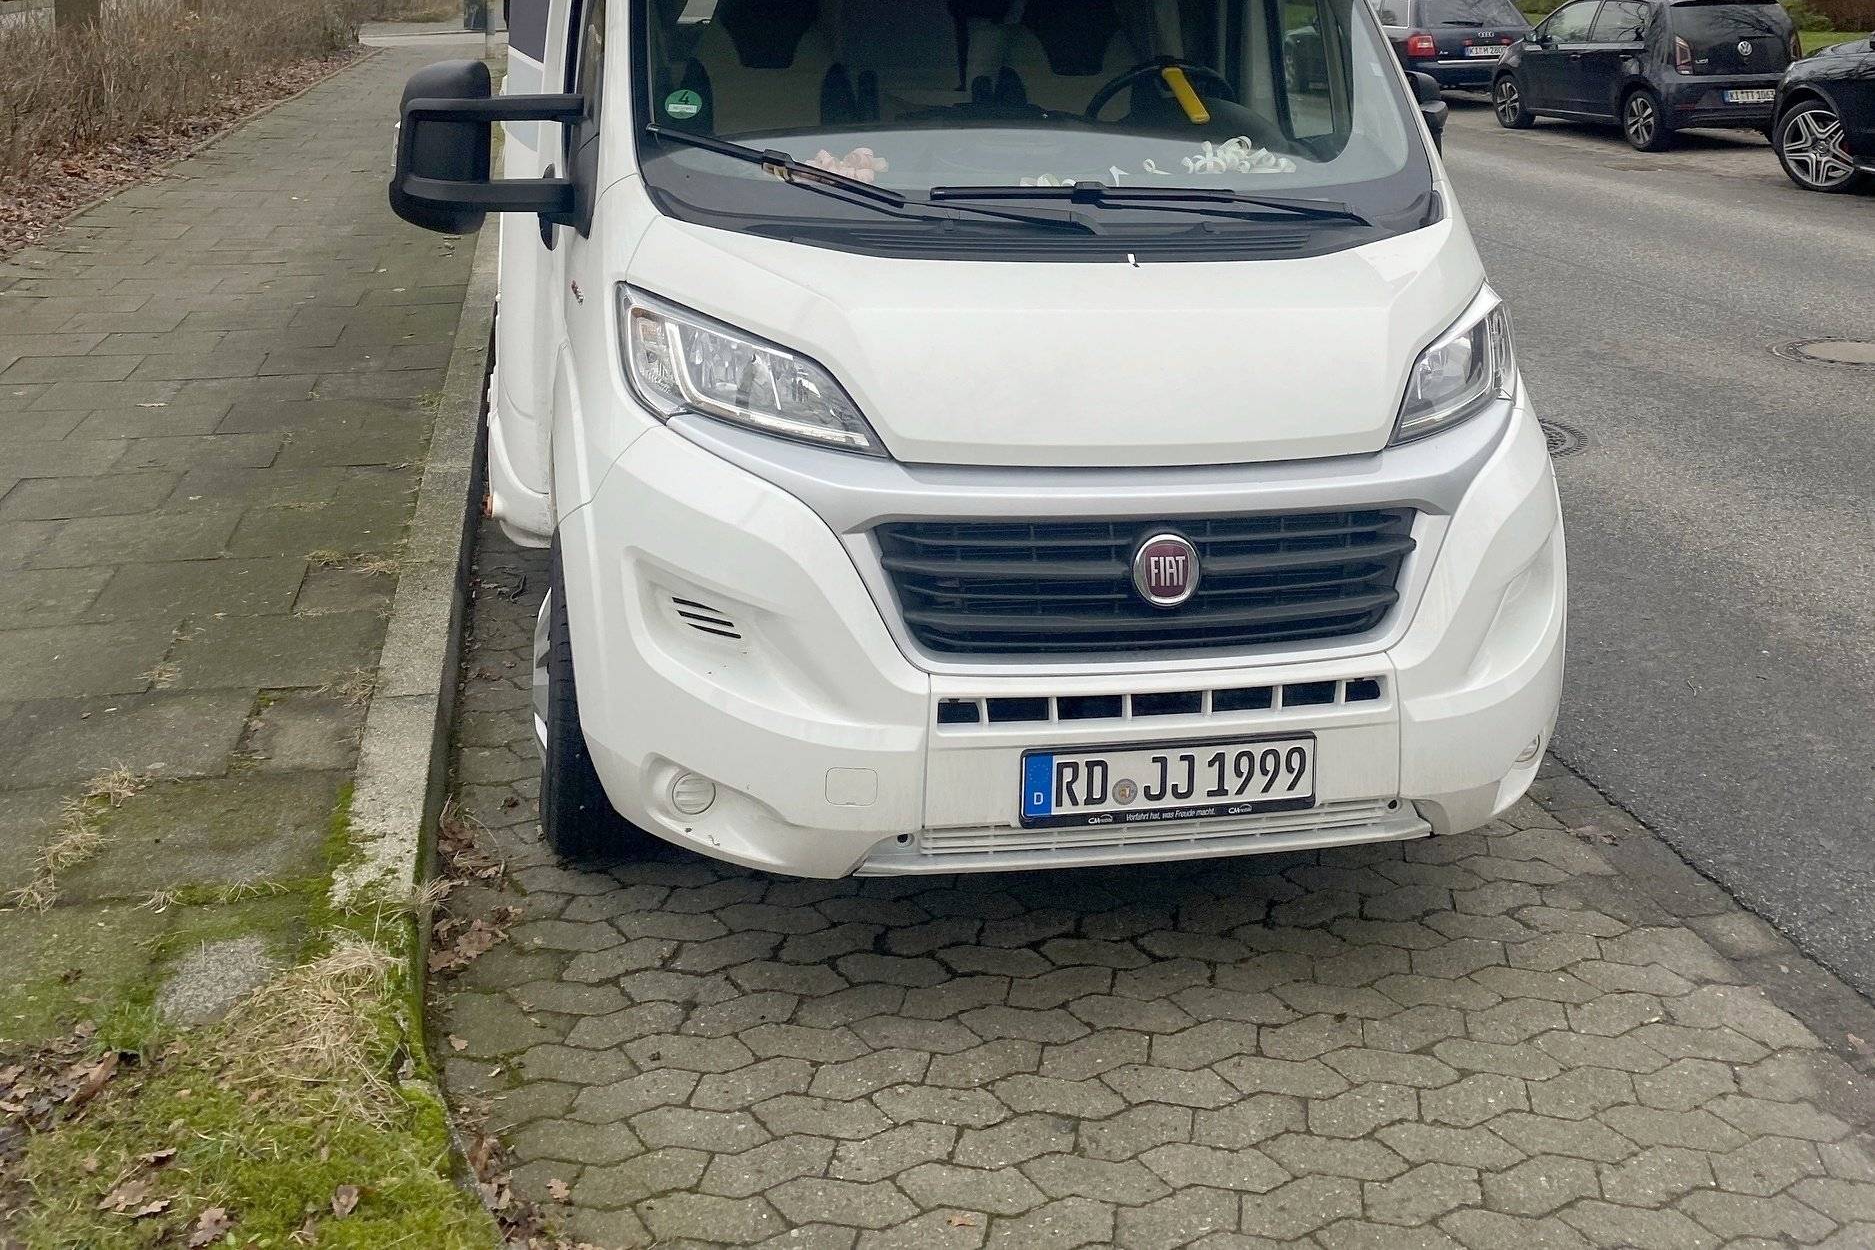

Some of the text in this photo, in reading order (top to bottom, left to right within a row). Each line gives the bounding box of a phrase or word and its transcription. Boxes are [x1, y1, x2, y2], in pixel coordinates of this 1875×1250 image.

[1150, 556, 1185, 587] FIAT
[1055, 746, 1307, 808] RD JJ 1999
[1033, 792, 1044, 805] D
